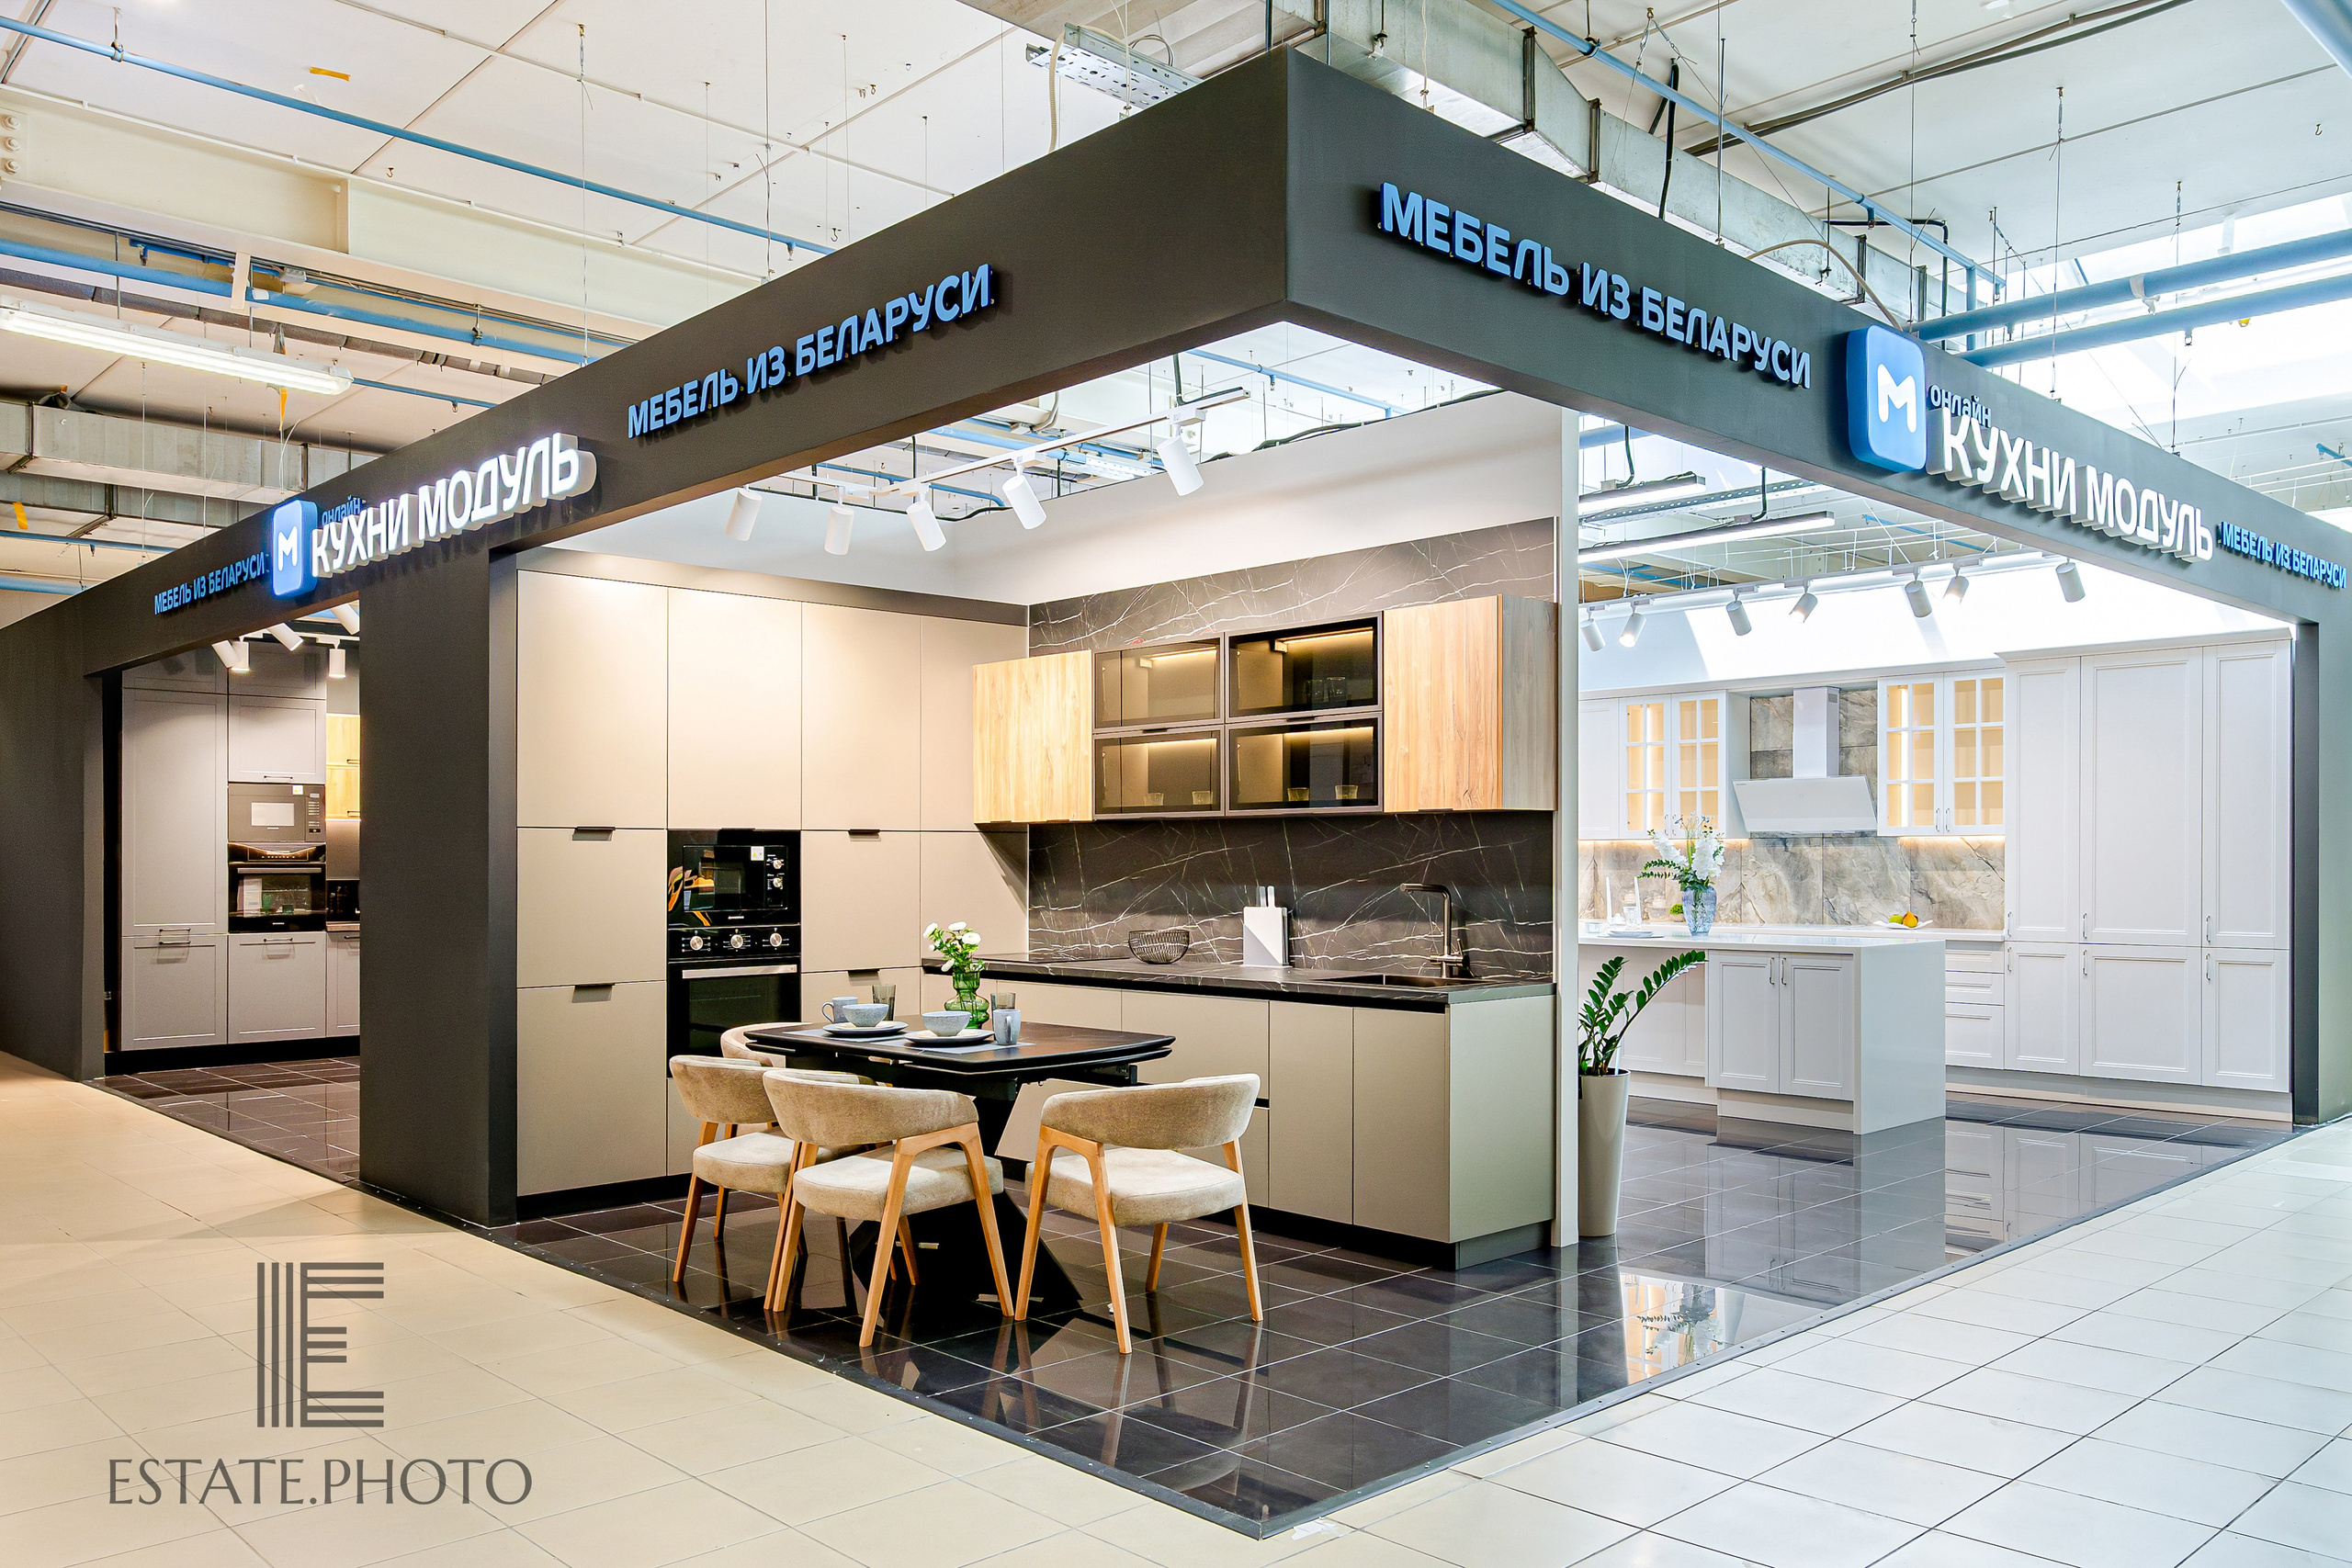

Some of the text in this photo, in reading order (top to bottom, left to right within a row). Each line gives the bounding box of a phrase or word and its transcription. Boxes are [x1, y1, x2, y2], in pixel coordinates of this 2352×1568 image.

[1380, 181, 1811, 389] МЕБЕЛЬ ИЗ БЕЛАРУСИ
[628, 263, 993, 439] МЕБЕЛЬ ИЗ БЕЛАРУСИ
[1929, 384, 1992, 429] онлайн
[311, 432, 581, 578] КУХНИ МОДУЛЬ
[322, 494, 361, 526] онлайн
[1942, 406, 2213, 560] КУХНИ МОДУЛЬ
[154, 551, 266, 615] МЕБЕЛЬ ИЗ БЕЛАРУСИ
[2222, 521, 2346, 589] МЕБЕЛЬ ИЗ БЕЛАРУСИ
